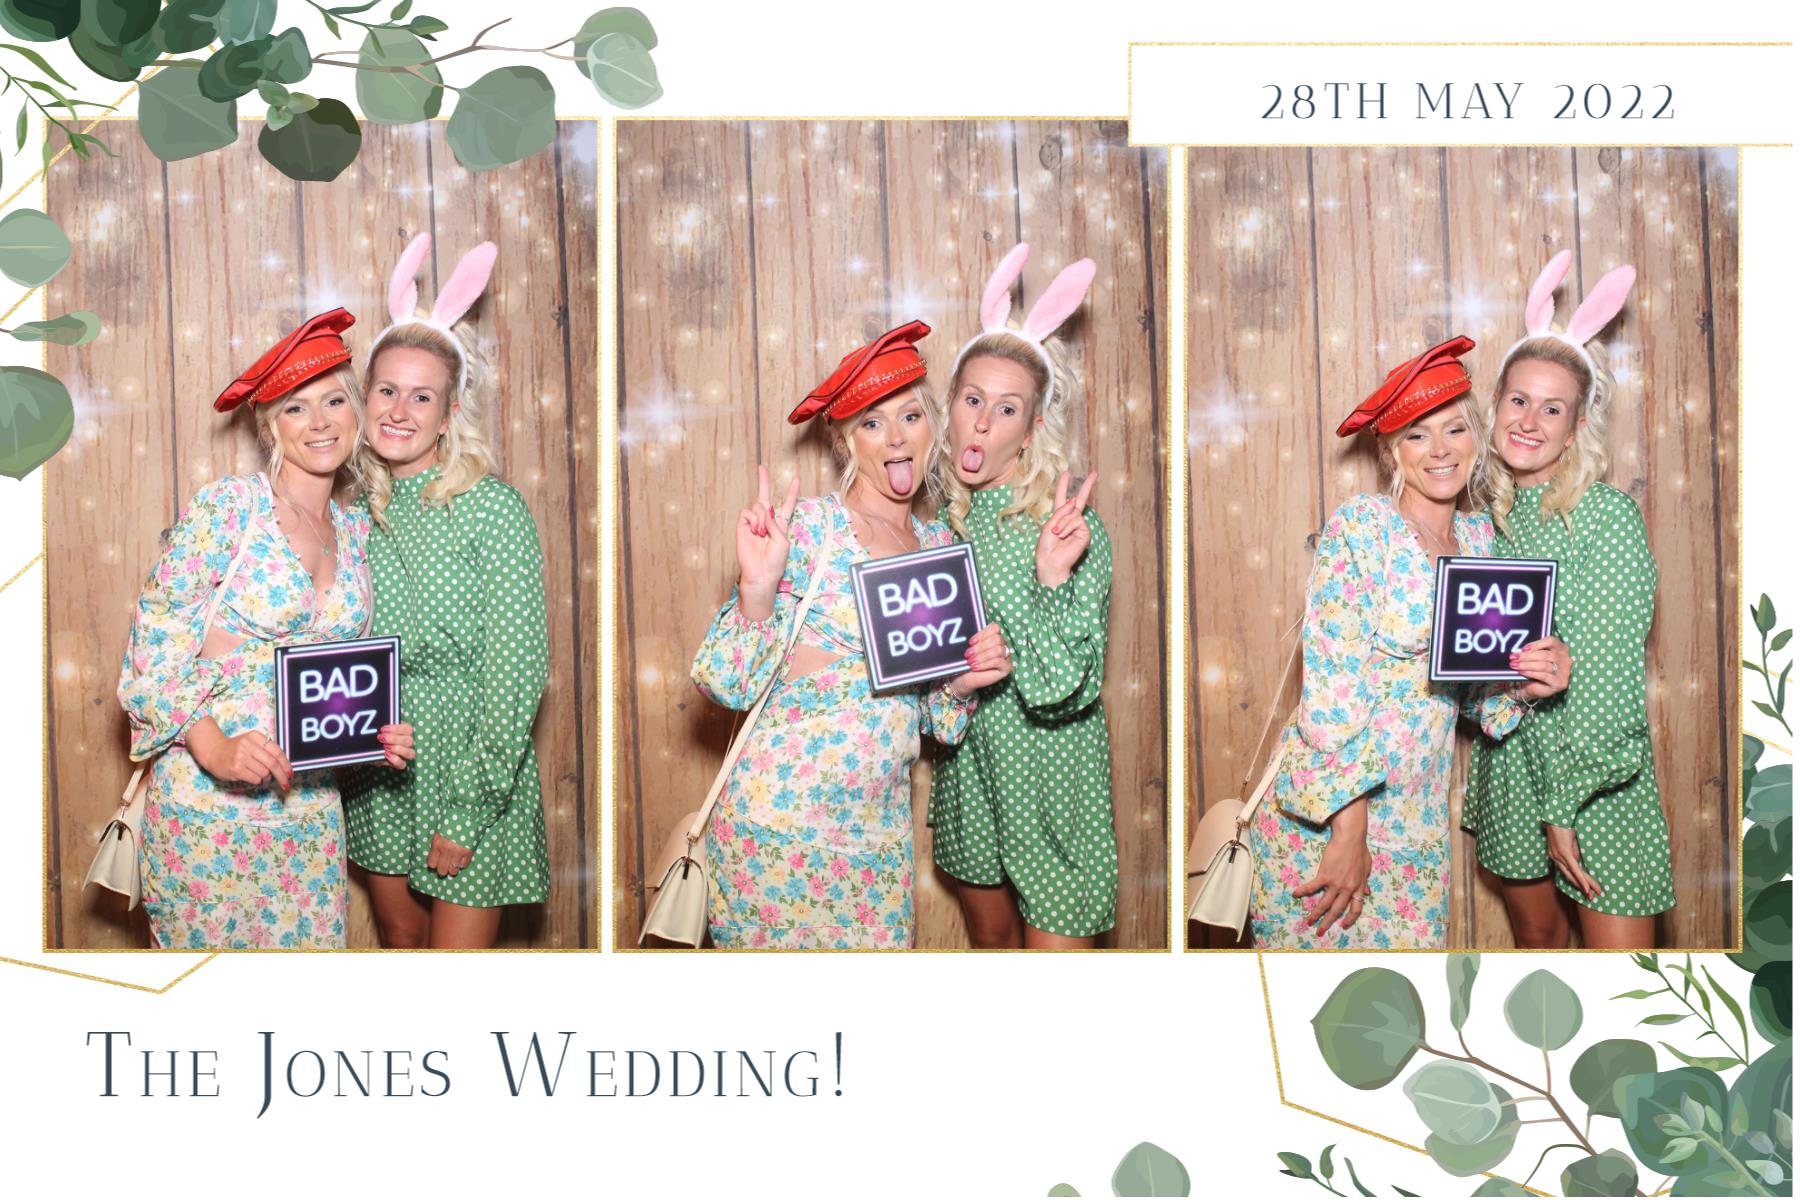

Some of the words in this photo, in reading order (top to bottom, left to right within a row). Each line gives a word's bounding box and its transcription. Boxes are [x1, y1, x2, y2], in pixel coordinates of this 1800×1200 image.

[876, 572, 958, 618] BAD
[1456, 582, 1534, 616] BAD
[887, 616, 967, 657] BOYZ
[1454, 628, 1530, 654] BOYZ
[299, 664, 379, 704] BAD
[301, 709, 378, 743] BOYZ
